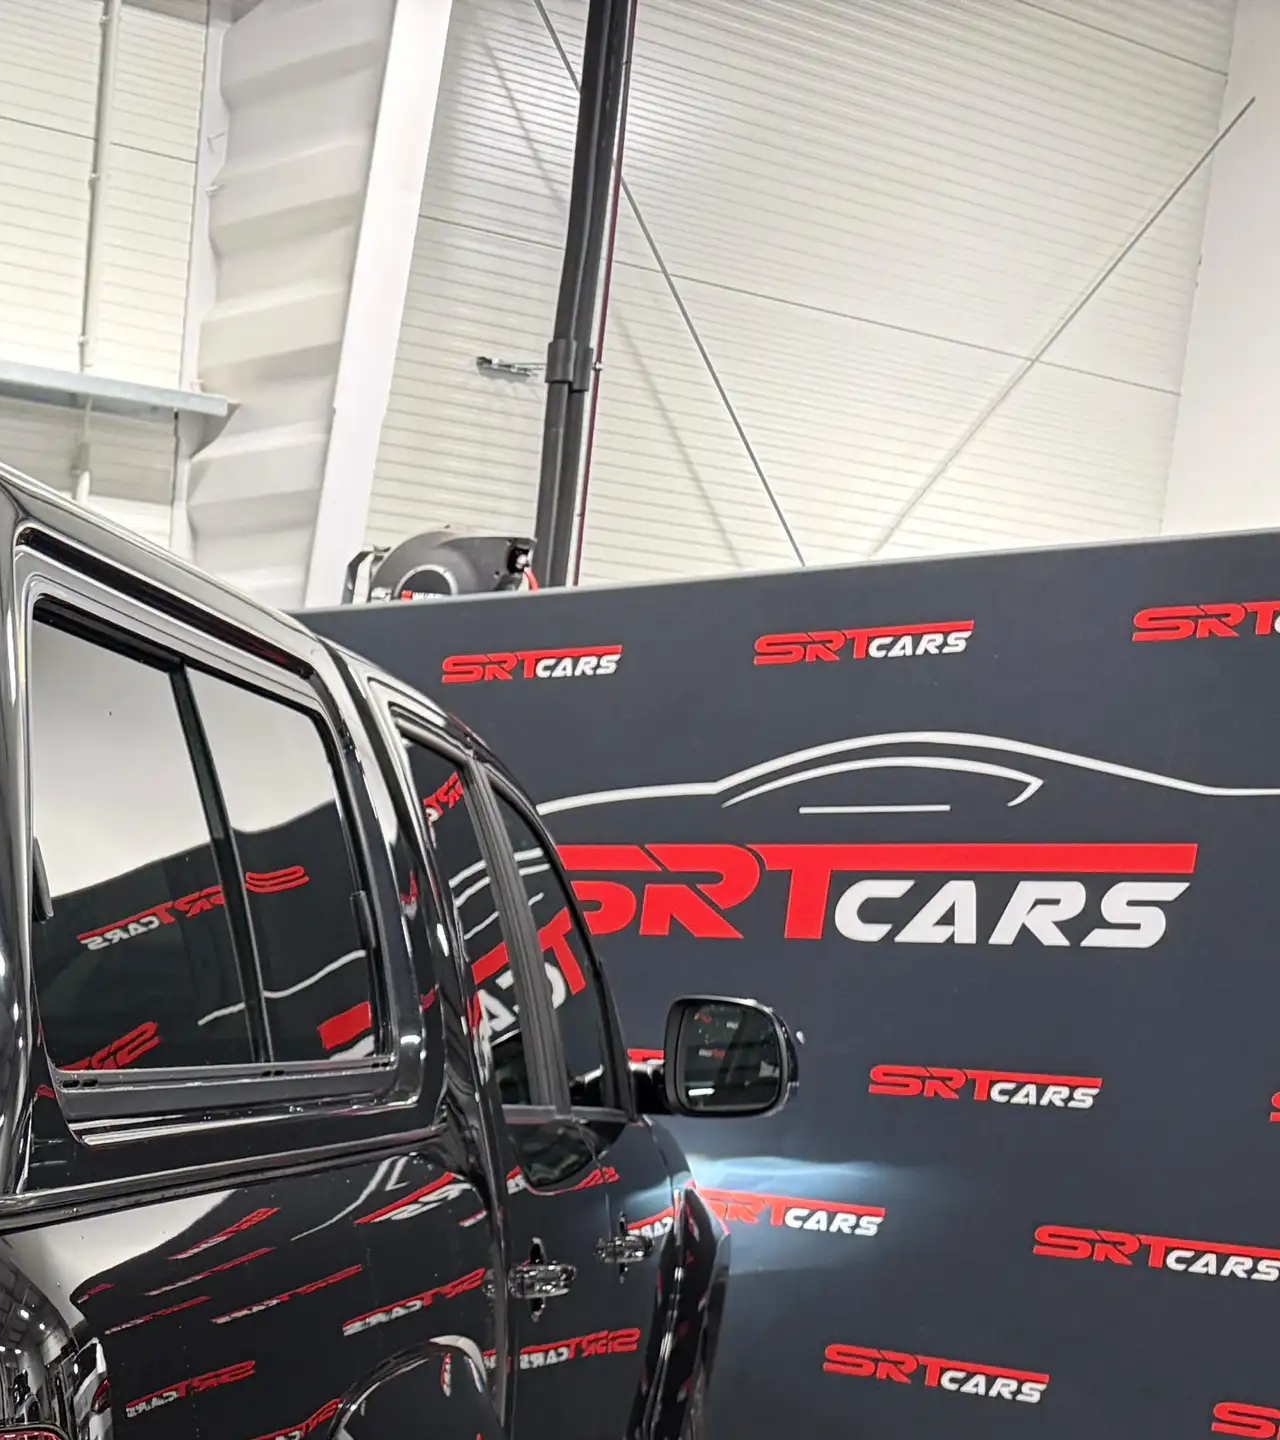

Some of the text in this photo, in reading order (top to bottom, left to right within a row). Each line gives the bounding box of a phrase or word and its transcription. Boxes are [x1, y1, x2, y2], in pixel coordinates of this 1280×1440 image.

[869, 631, 973, 659] CARS
[536, 653, 622, 679] CARS
[834, 879, 1191, 949] CARS
[990, 1083, 1101, 1109] CARS
[785, 1207, 885, 1237] CARS
[941, 1371, 1048, 1404] CARS
